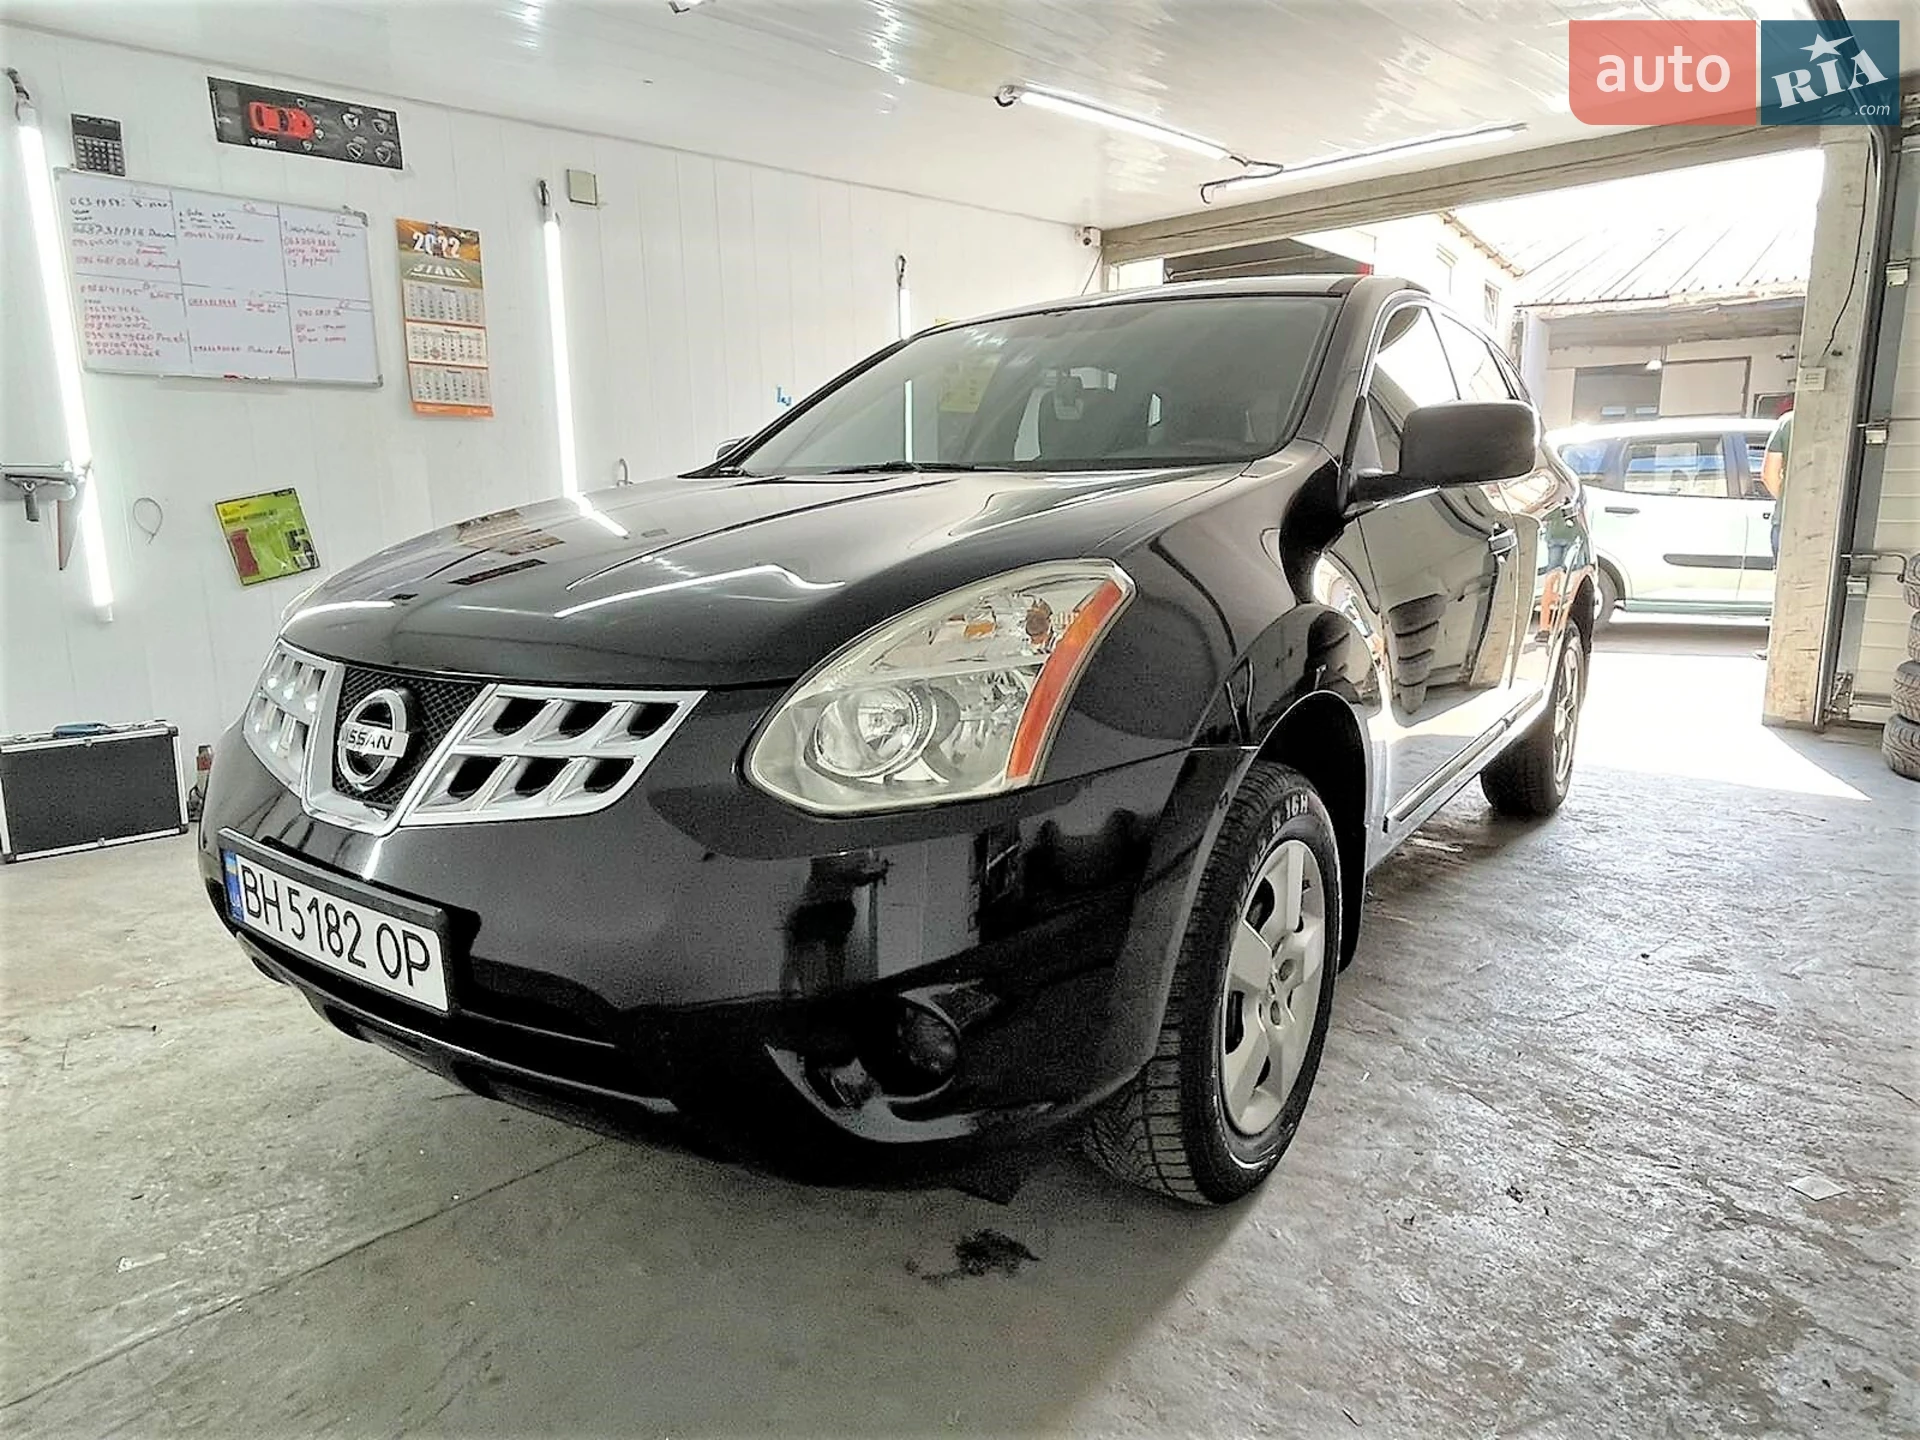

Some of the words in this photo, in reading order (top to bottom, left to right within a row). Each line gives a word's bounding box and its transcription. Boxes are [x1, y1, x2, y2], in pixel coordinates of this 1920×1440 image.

[412, 231, 461, 258] 2022
[413, 264, 466, 279] START
[242, 866, 283, 932] BH
[288, 888, 366, 969] 5182
[376, 922, 431, 987] OP
